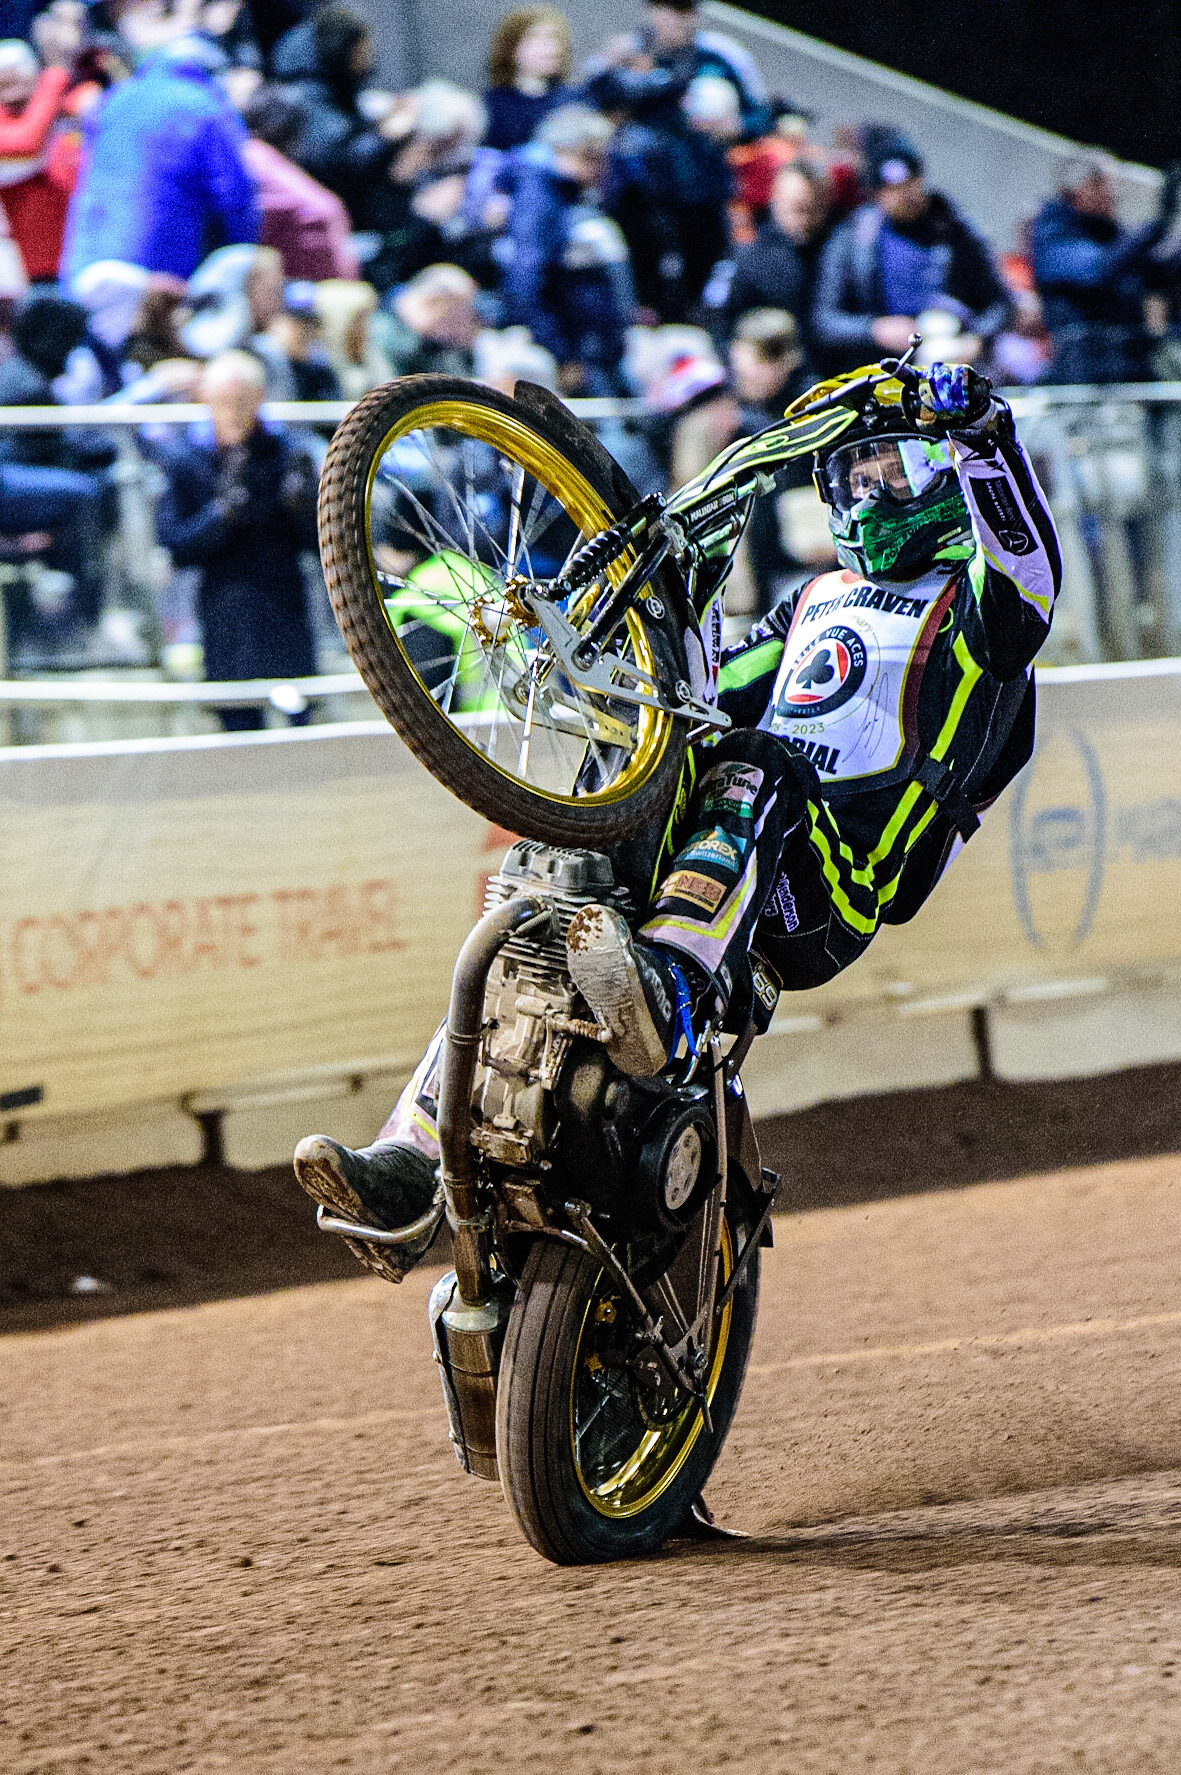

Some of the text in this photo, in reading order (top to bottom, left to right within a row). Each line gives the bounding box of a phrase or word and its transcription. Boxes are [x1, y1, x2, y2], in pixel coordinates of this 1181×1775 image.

[843, 586, 929, 618] CRAVEN
[825, 627, 848, 640] VUE
[846, 637, 863, 667] ACES
[791, 721, 825, 734] 2023
[780, 735, 840, 775] RIAL
